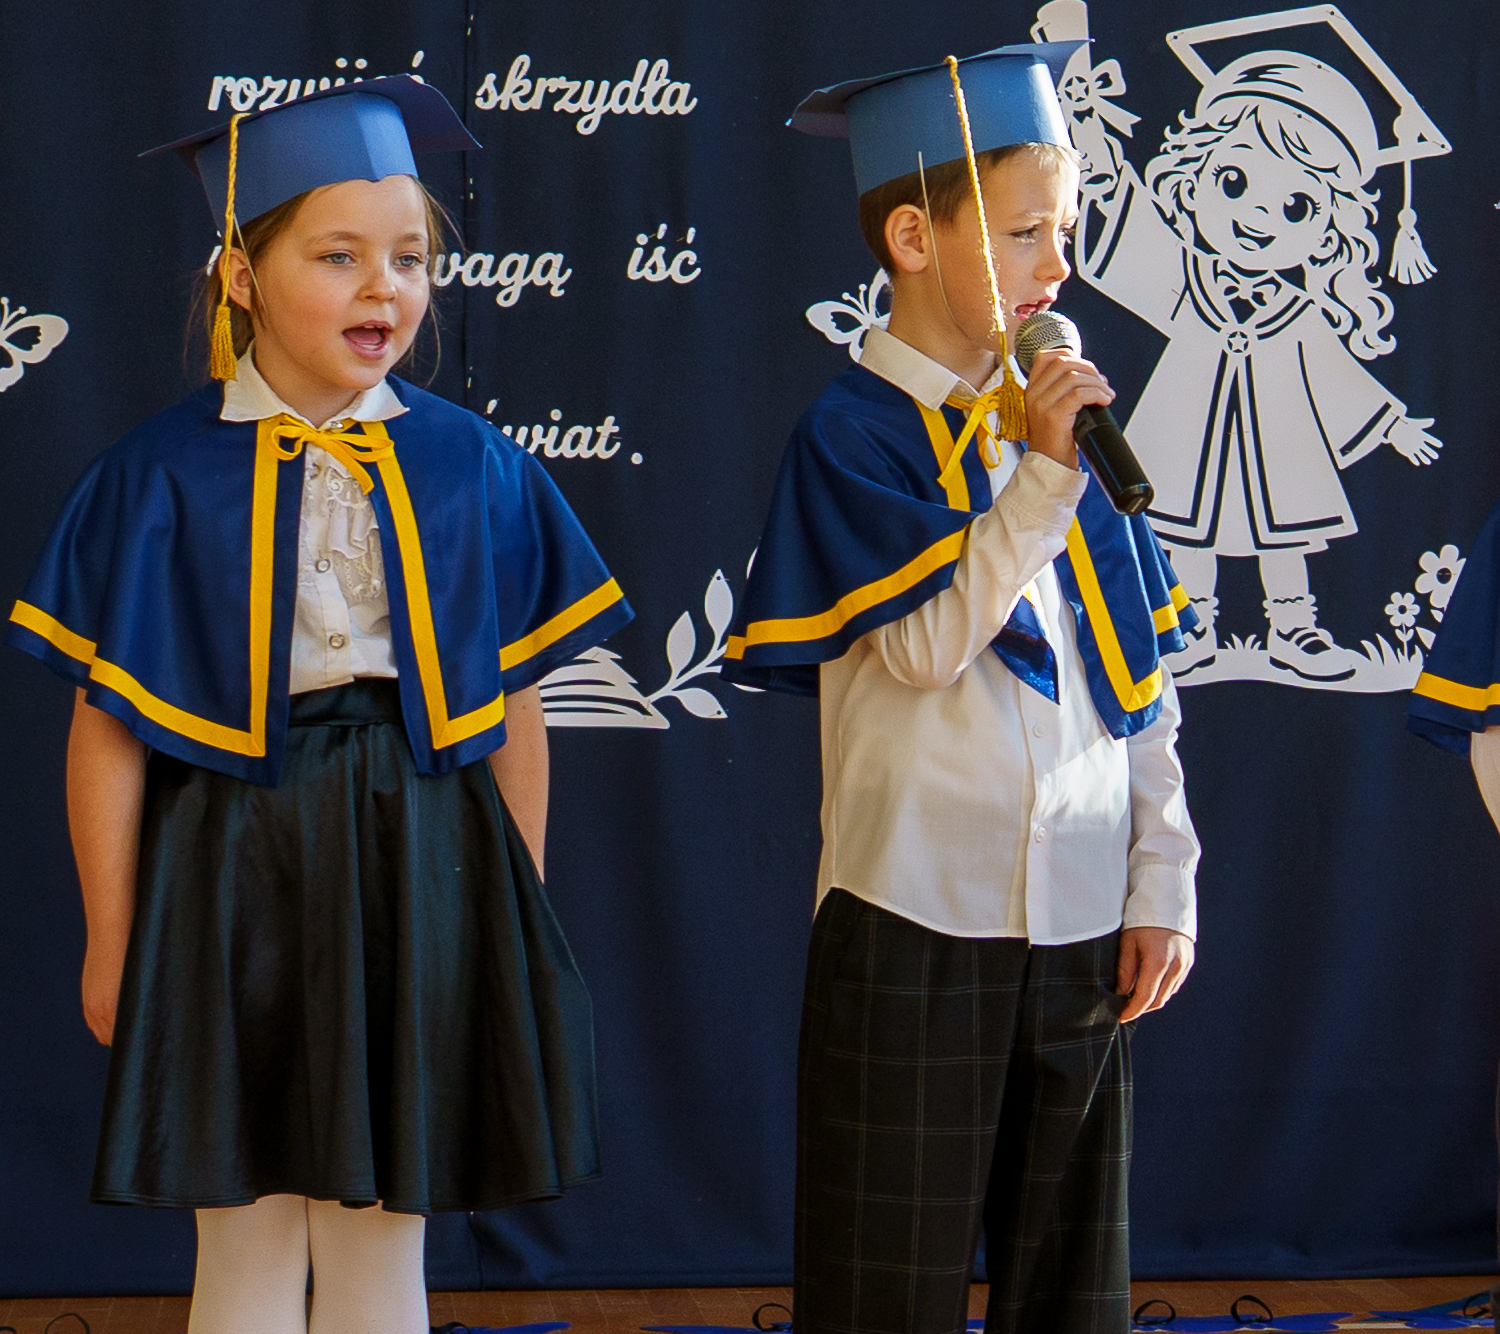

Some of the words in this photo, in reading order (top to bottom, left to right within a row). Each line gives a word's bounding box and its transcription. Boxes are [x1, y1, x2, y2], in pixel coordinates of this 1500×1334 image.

[475, 53, 699, 137] skrzydła
[626, 222, 702, 284] iść
[486, 398, 644, 466] wiat.
